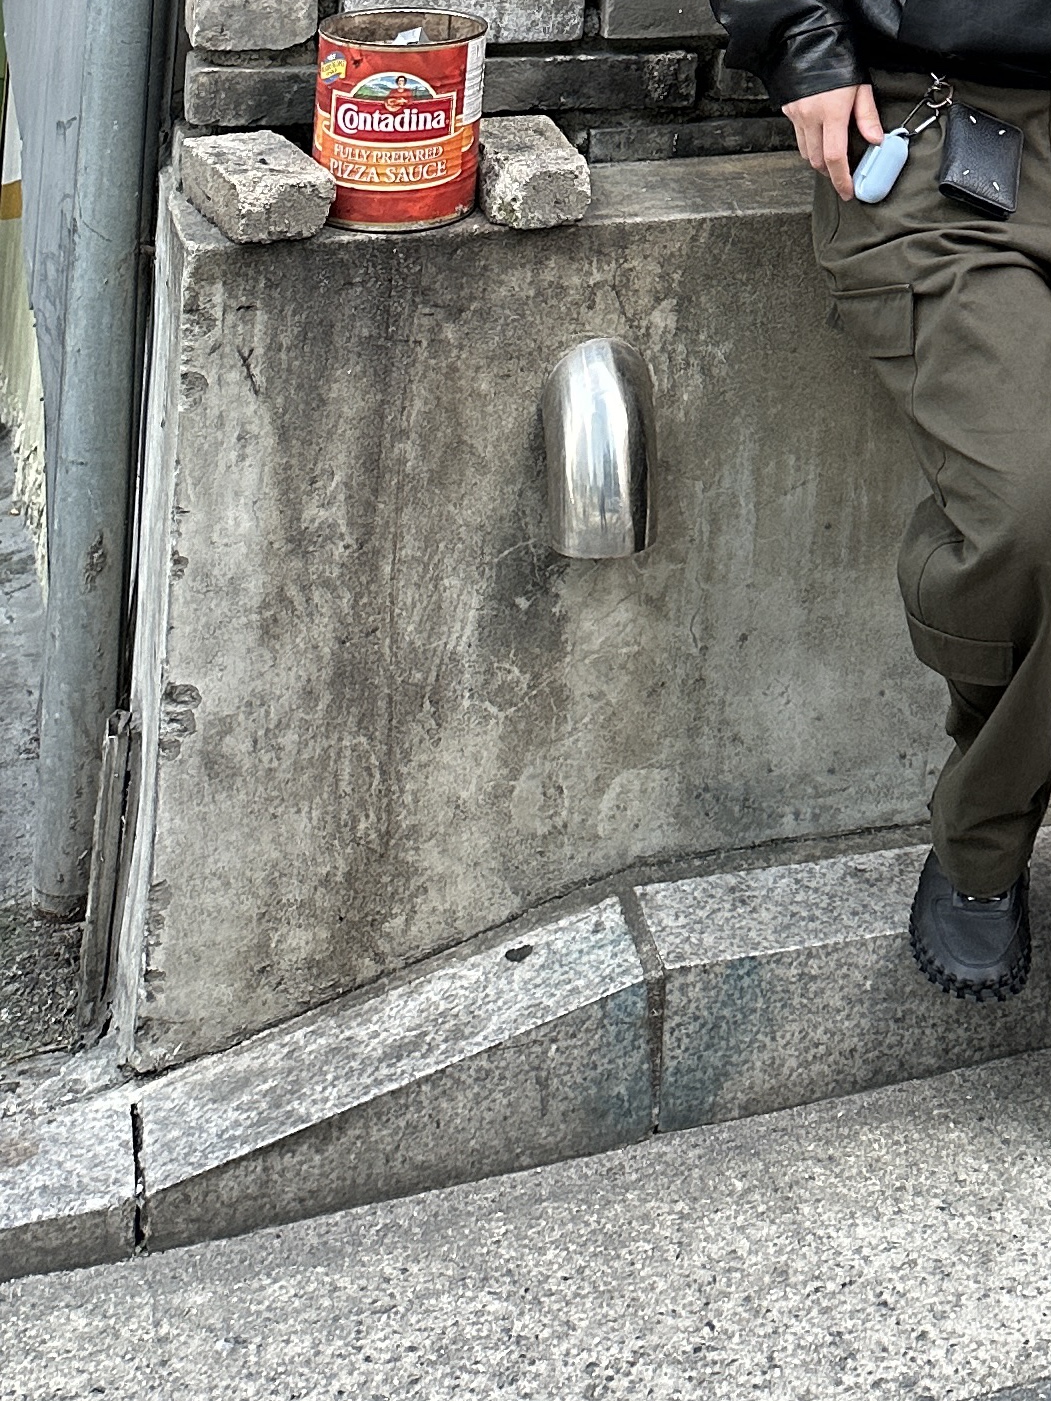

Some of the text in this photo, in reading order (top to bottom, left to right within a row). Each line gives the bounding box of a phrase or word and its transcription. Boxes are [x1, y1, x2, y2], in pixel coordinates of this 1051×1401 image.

[336, 102, 446, 135] Contadina
[333, 142, 444, 164] FULLY PREPARED
[328, 157, 447, 184] PIZZA SAUCE
